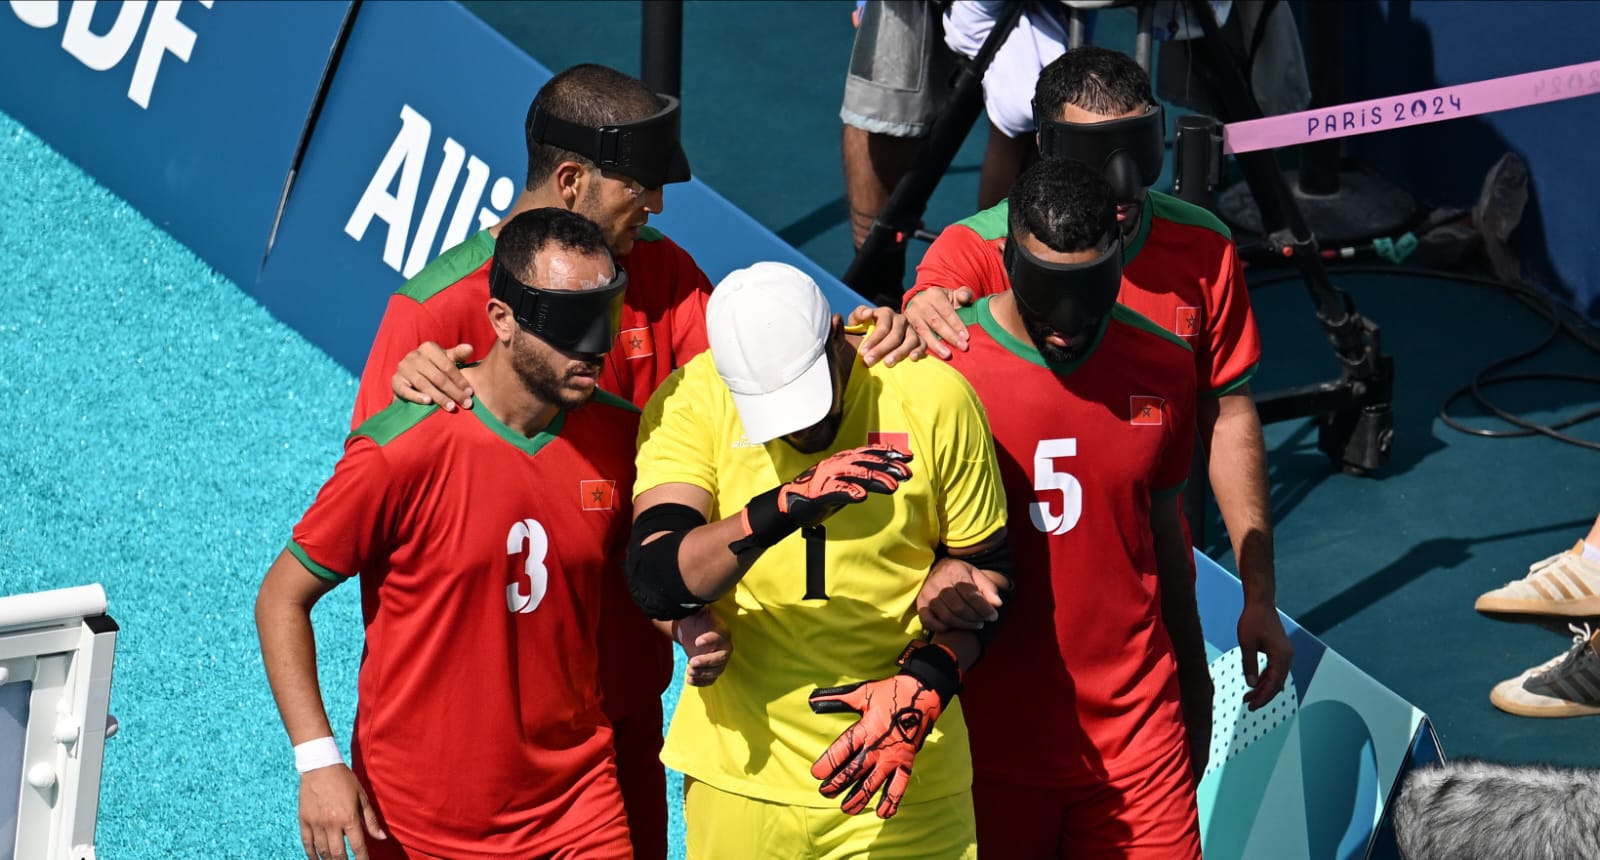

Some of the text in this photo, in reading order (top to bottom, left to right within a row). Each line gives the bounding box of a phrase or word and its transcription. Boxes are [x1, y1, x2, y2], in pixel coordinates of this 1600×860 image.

[1393, 94, 1461, 122] 2024
[1029, 437, 1083, 536] 5
[506, 518, 549, 614] 3
[801, 523, 831, 601] 1
